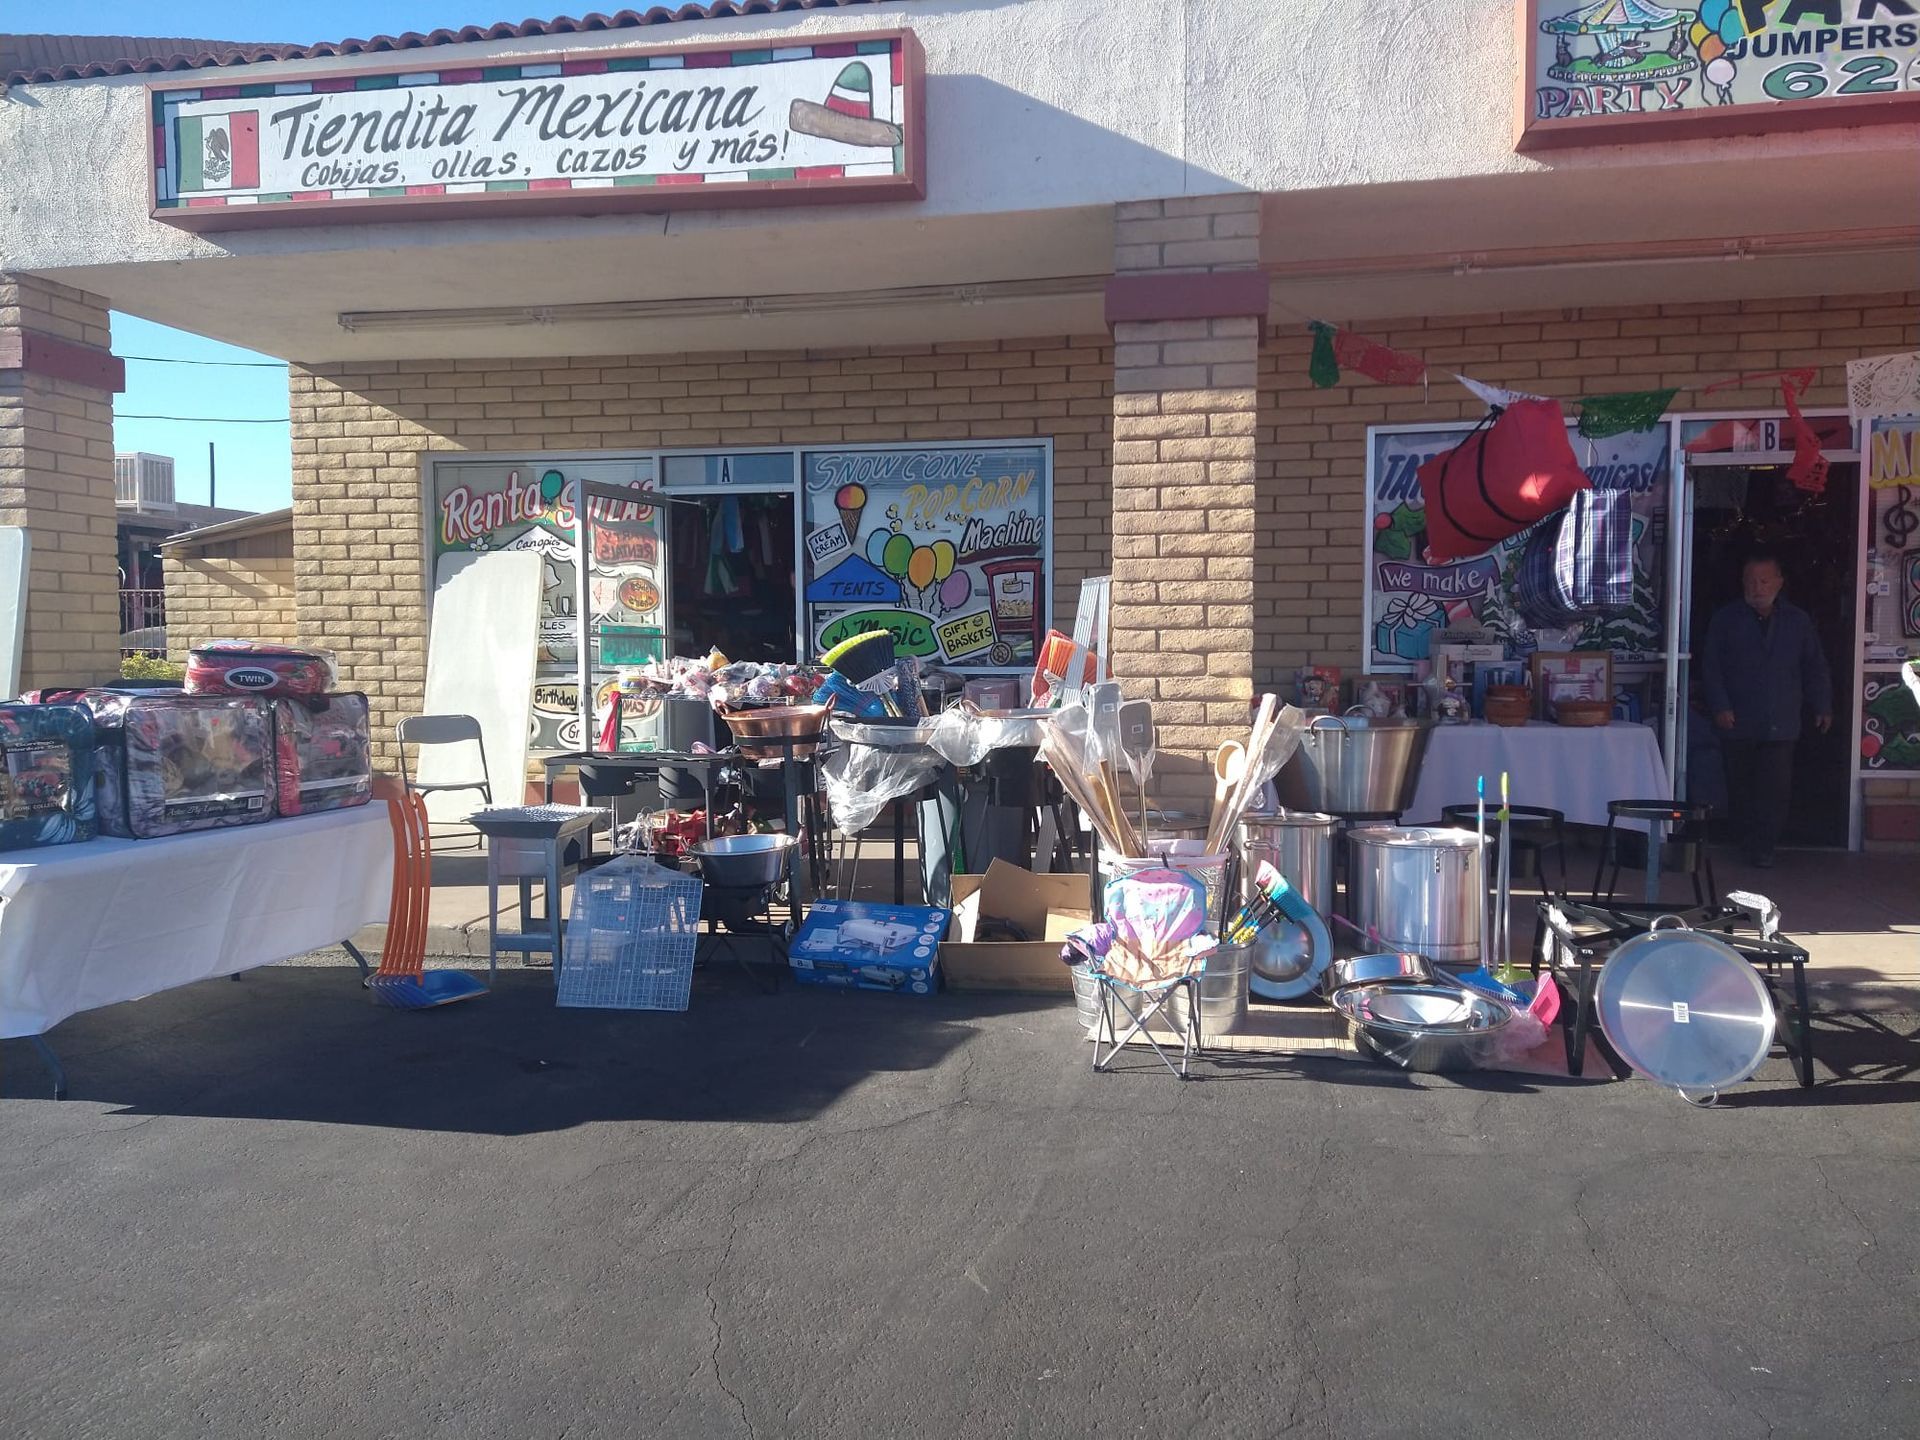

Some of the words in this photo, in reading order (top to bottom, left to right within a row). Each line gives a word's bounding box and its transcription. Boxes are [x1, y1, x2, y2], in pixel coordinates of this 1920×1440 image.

[1728, 23, 1919, 60] JUMPERS
[1762, 56, 1920, 100] 62
[1537, 79, 1692, 118] PARTY
[270, 90, 478, 161] Tiendita
[493, 82, 766, 142] Mexicana
[301, 159, 406, 189] Cobijas,
[431, 149, 532, 180] ollas,
[556, 143, 647, 174] cazos
[675, 138, 702, 171] y
[710, 130, 791, 165] más!
[1765, 422, 1777, 450] B
[721, 457, 731, 484] A
[806, 455, 902, 492] SNOW
[902, 453, 984, 480] CONE
[443, 471, 541, 543] Renta
[902, 483, 959, 520] POP
[958, 468, 1036, 512] CORN
[814, 533, 831, 545] ICE
[814, 534, 845, 555] CREAM
[960, 511, 1044, 554] Machine
[830, 580, 886, 596] TENTS
[1384, 567, 1412, 587] we
[1422, 568, 1484, 593] make
[854, 619, 925, 646] Msic
[943, 622, 969, 638] GIFT
[946, 626, 993, 651] BASKETS
[238, 673, 265, 684] TWIN
[535, 688, 577, 711] Birthday
